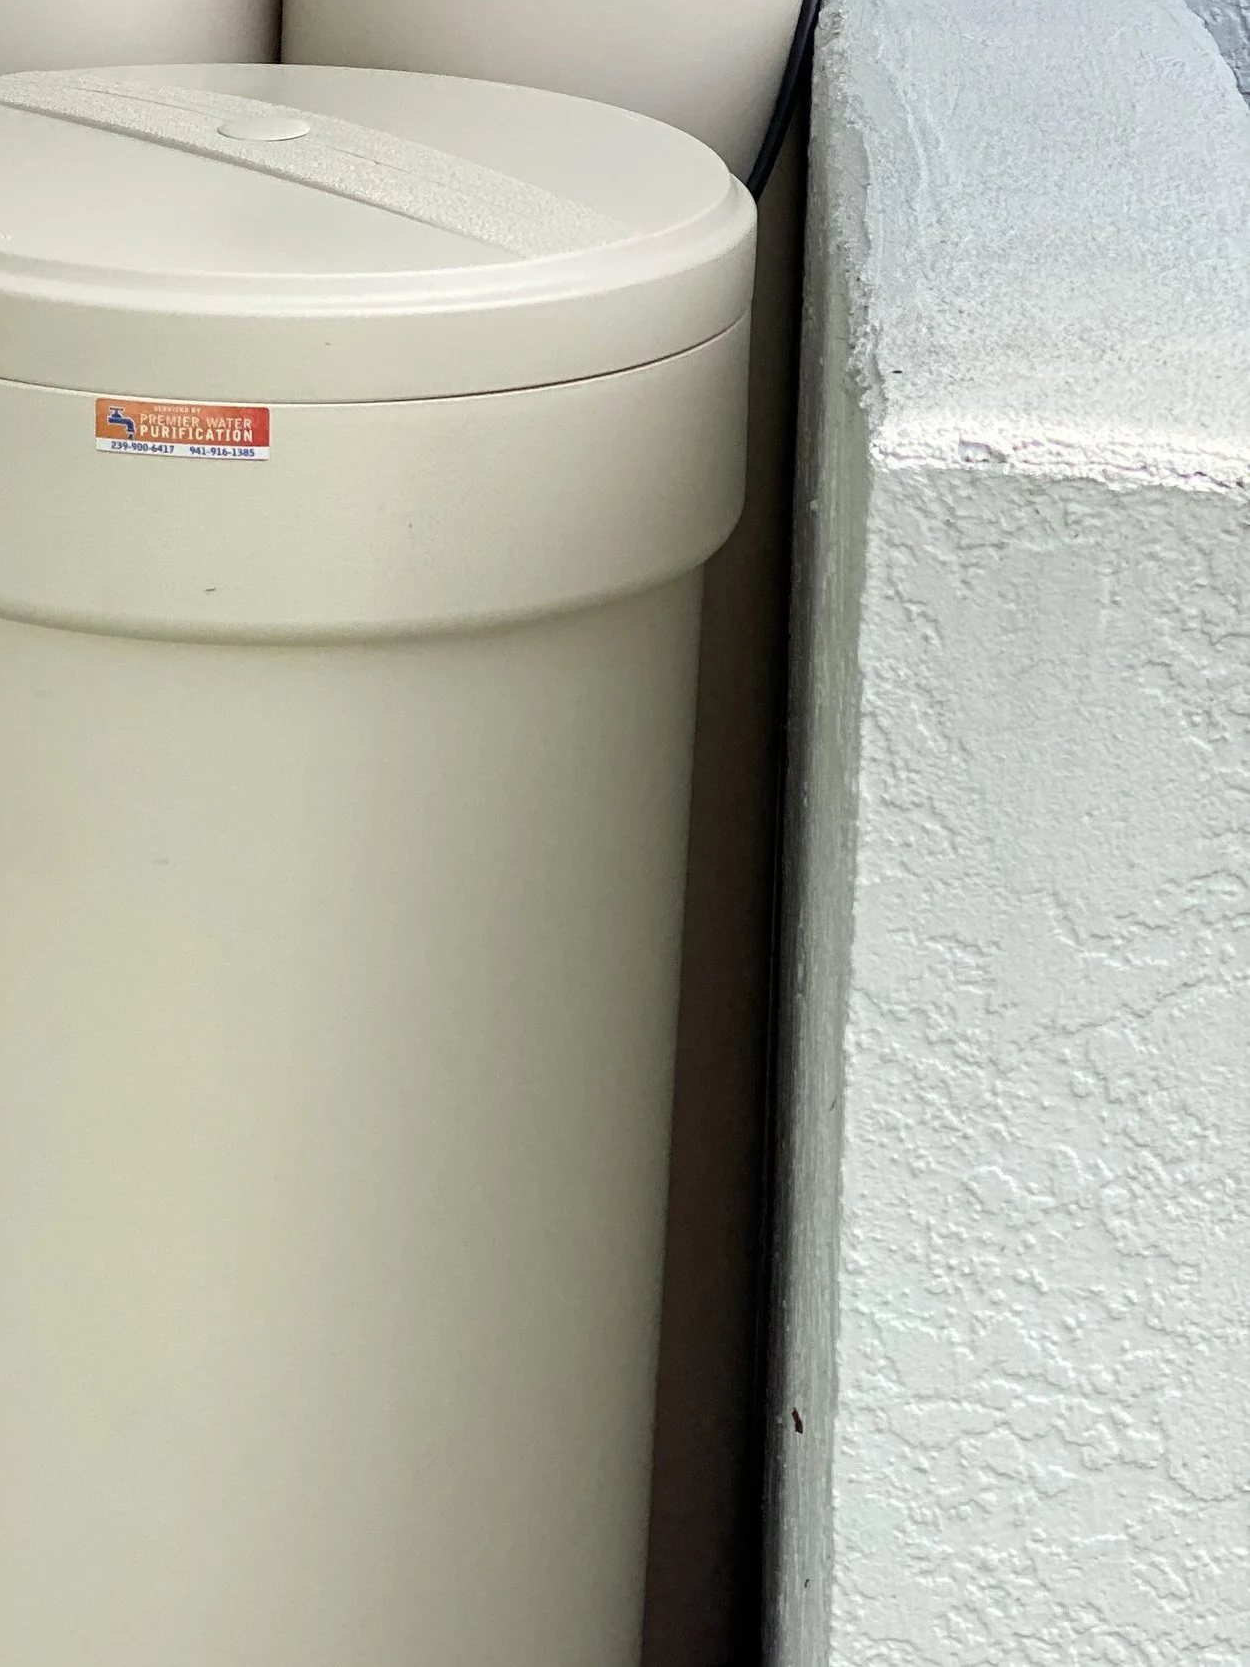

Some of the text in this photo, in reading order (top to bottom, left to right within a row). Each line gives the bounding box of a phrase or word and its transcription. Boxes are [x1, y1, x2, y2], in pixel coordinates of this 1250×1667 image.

[139, 413, 252, 430] PREMIER WATER
[139, 425, 253, 443] PURIFICATION
[111, 440, 255, 457] 239-900-6417 941-916-1385
